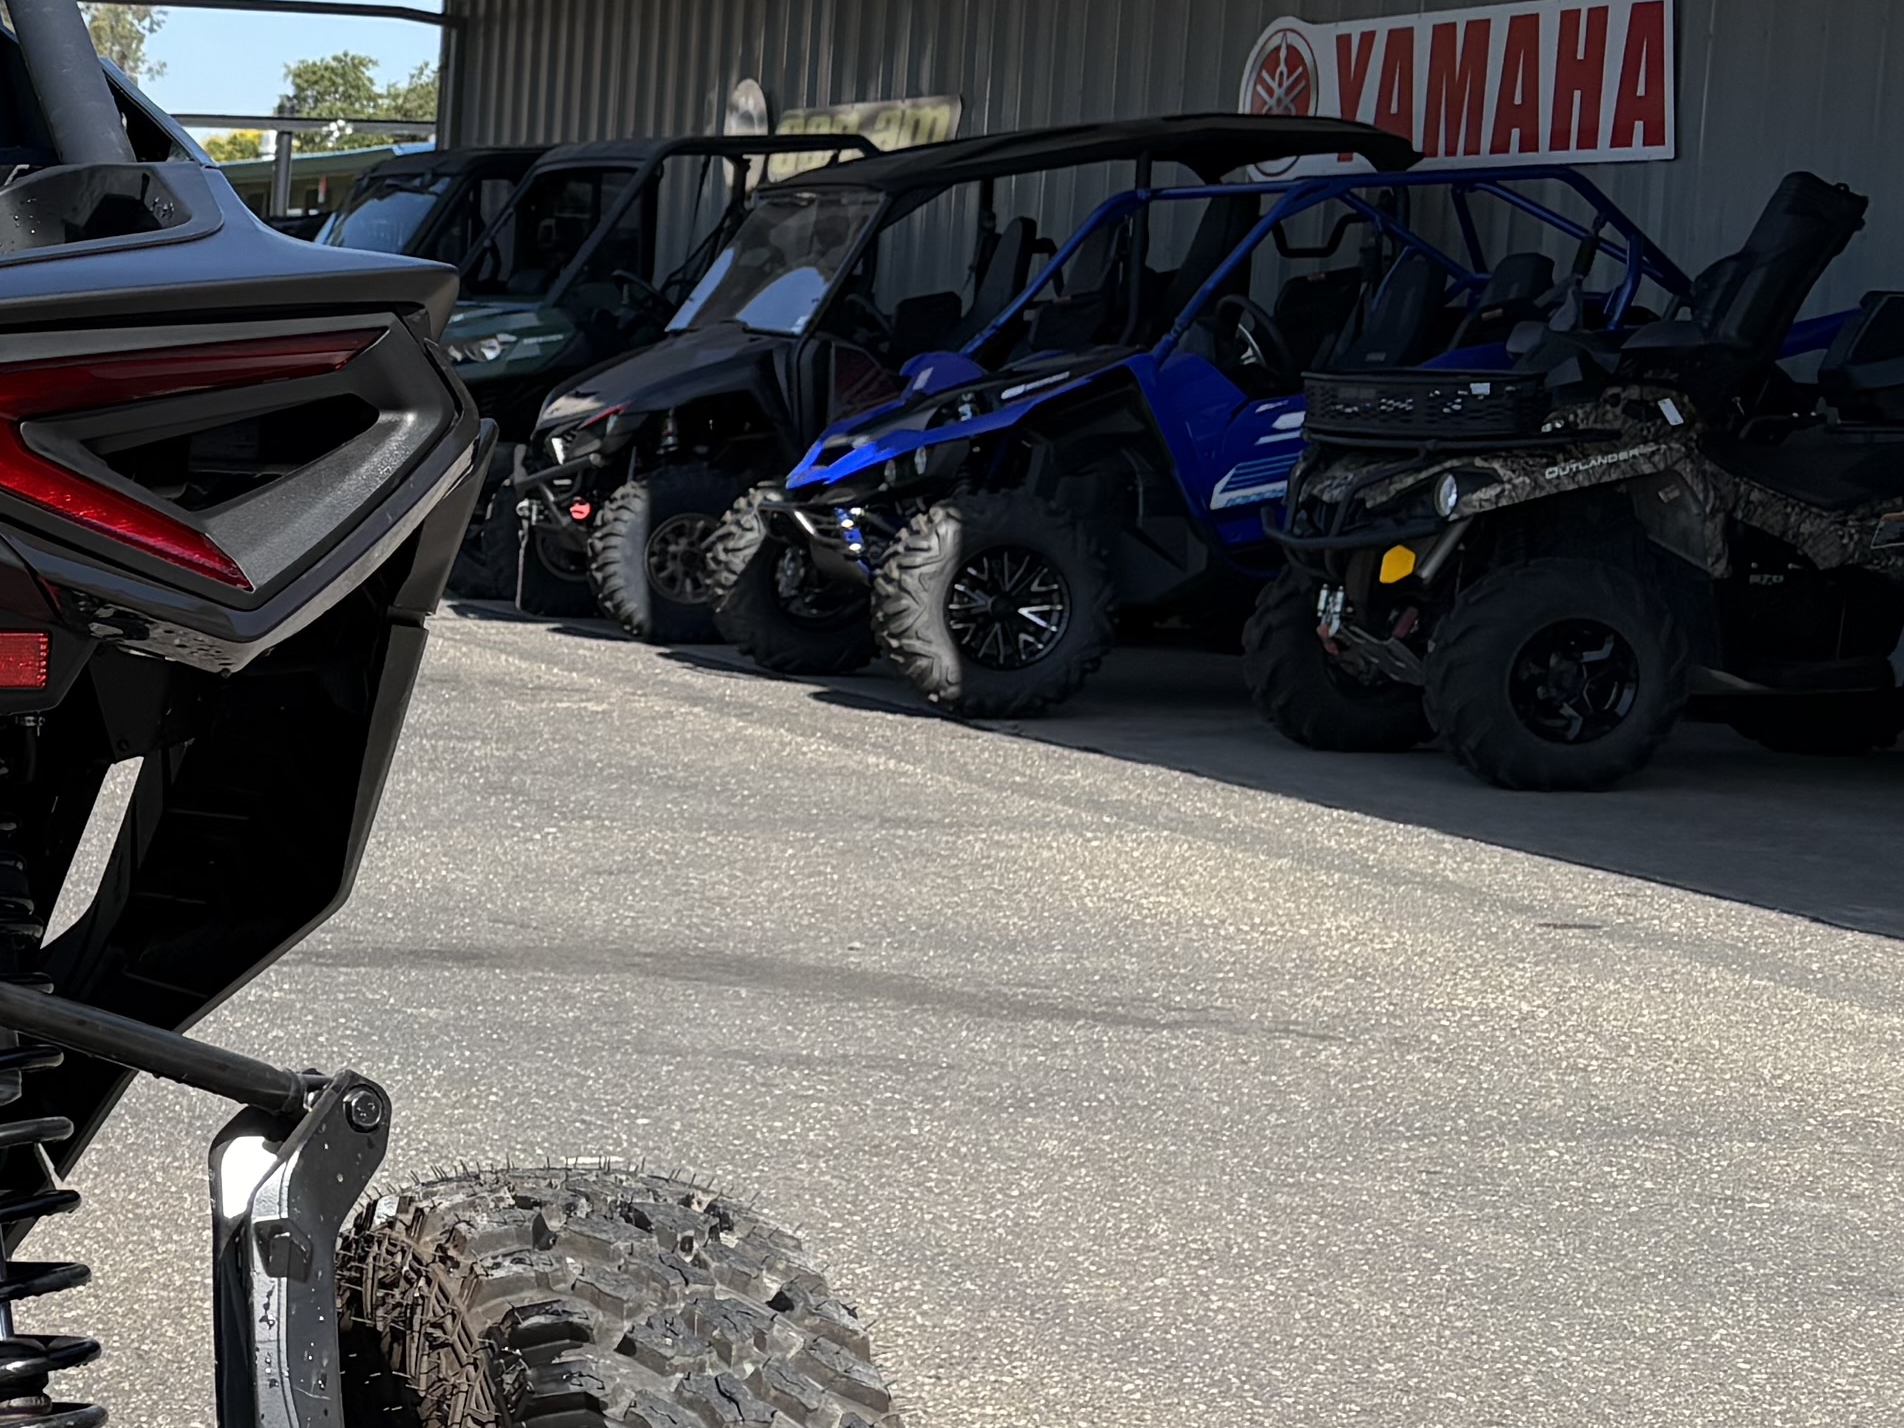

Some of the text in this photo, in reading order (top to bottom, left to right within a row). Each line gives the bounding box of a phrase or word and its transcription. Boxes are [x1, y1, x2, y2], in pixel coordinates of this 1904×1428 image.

[1335, 0, 1666, 163] YAMAHA
[769, 103, 950, 180] canam
[1544, 448, 1639, 479] OUTLANDER
